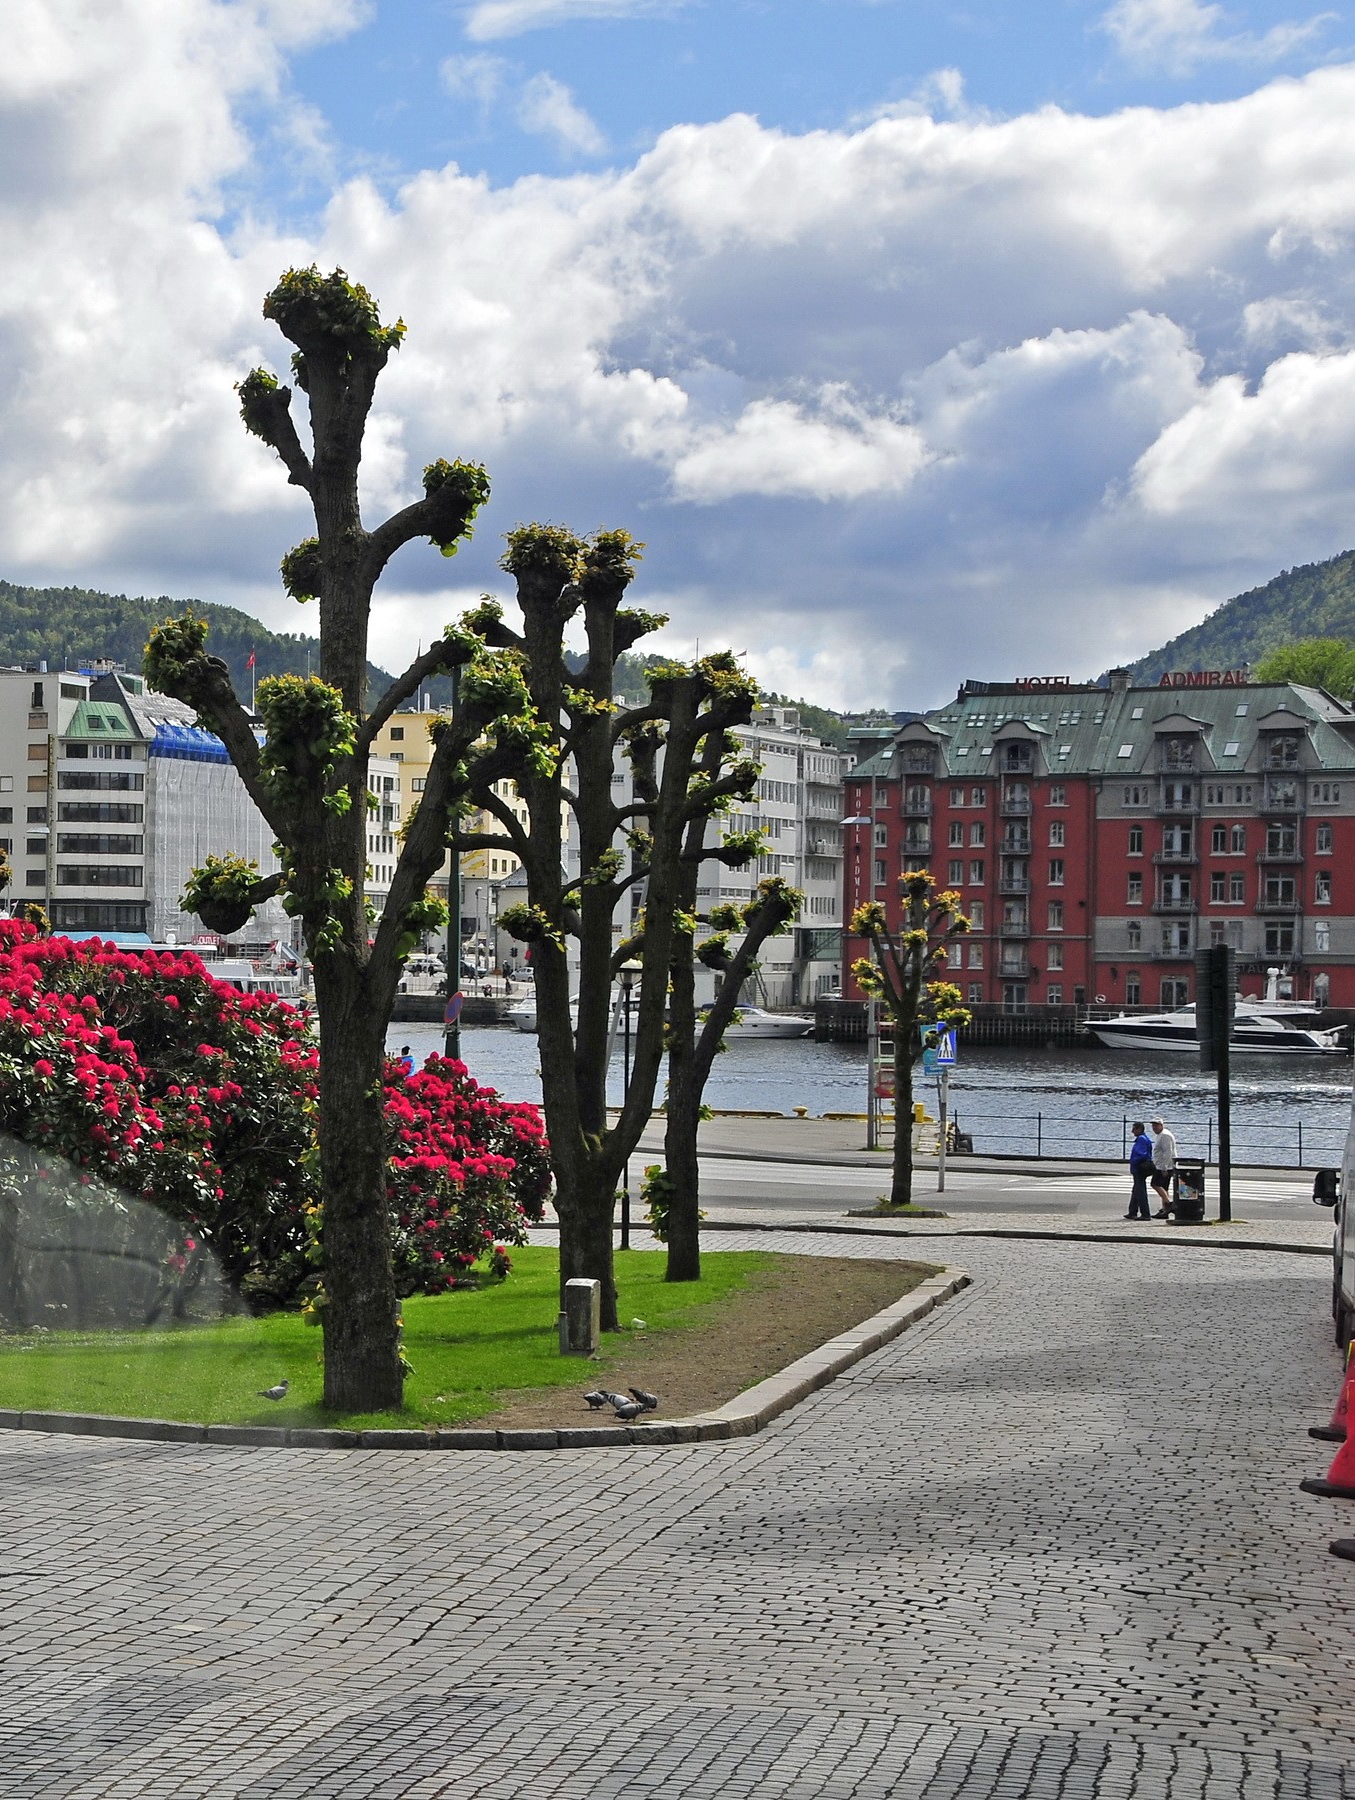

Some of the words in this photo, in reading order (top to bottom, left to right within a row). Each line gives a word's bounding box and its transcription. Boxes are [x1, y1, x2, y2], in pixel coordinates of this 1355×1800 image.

[1015, 676, 1071, 689] HOTEL
[1158, 670, 1247, 687] ADMIRAL
[199, 936, 220, 945] OUTLET
